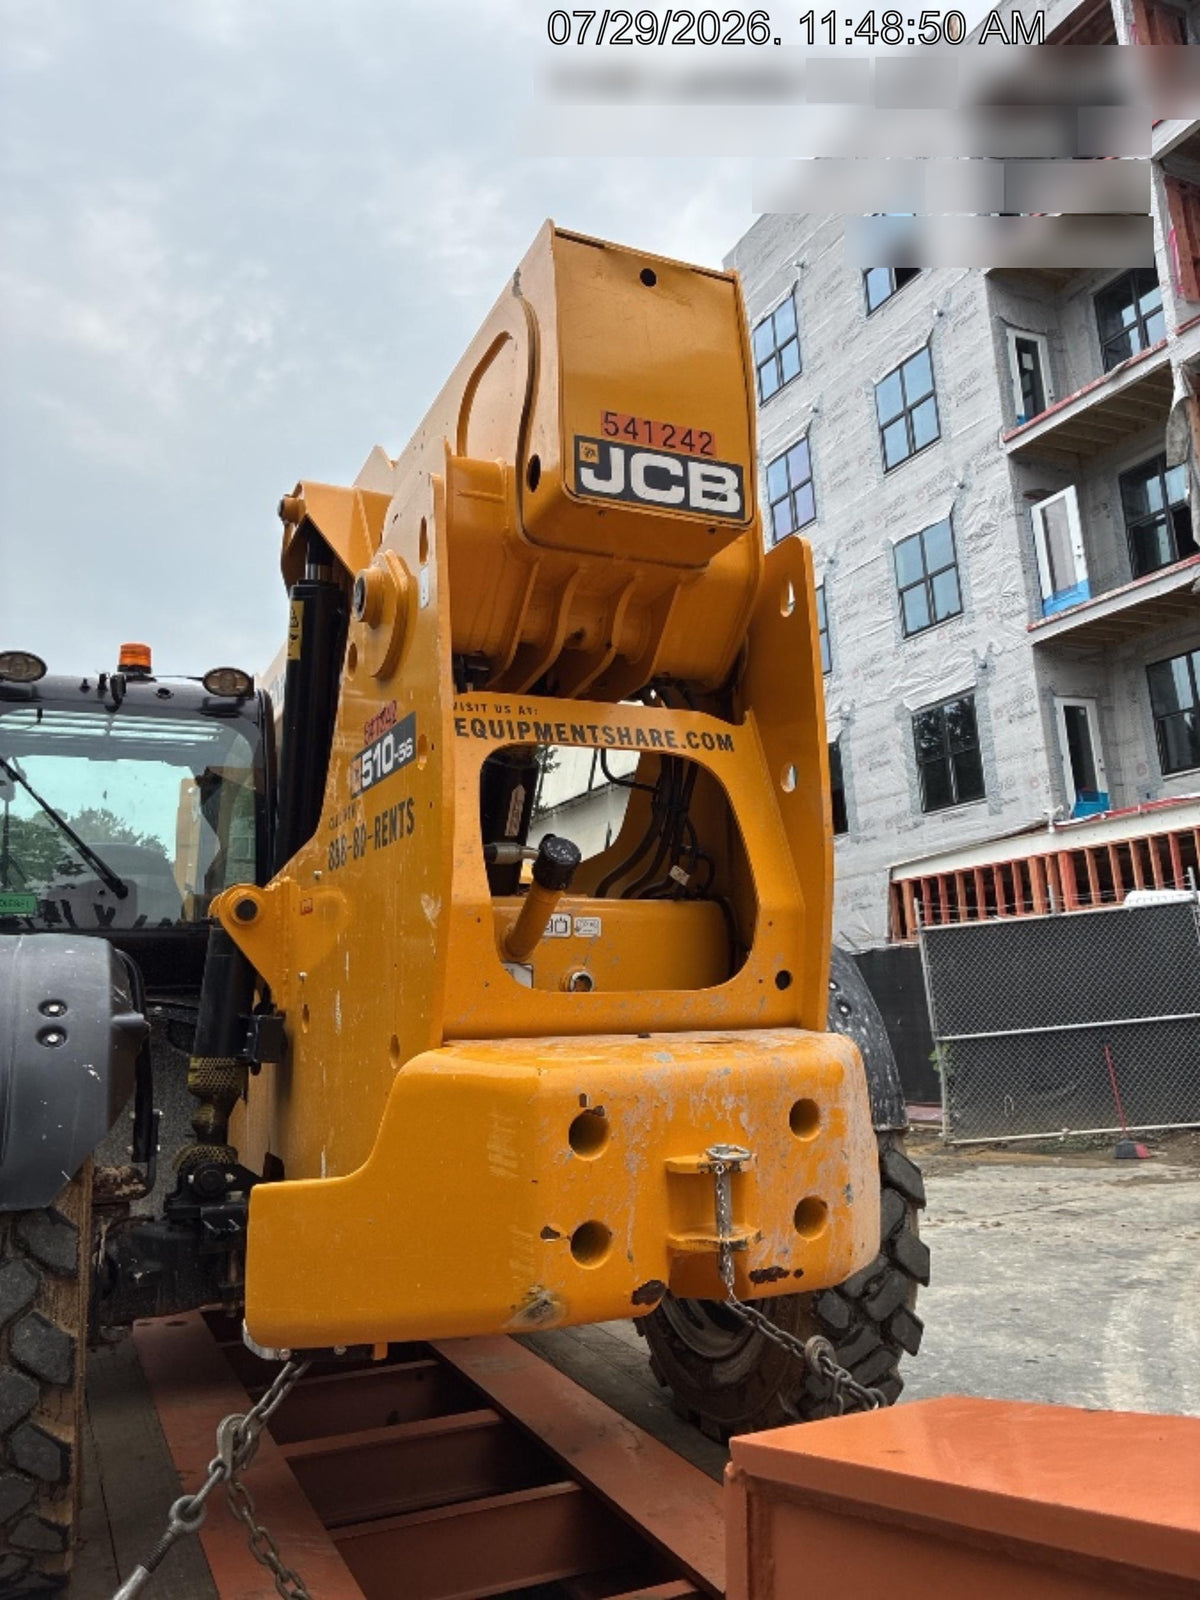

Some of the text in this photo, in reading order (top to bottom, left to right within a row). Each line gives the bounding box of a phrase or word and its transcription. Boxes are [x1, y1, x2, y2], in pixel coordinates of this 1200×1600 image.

[603, 411, 714, 456] 541242
[580, 446, 741, 513] JCB
[494, 704, 512, 714] US
[454, 717, 735, 752] EQUIPMENTSHARE.COM
